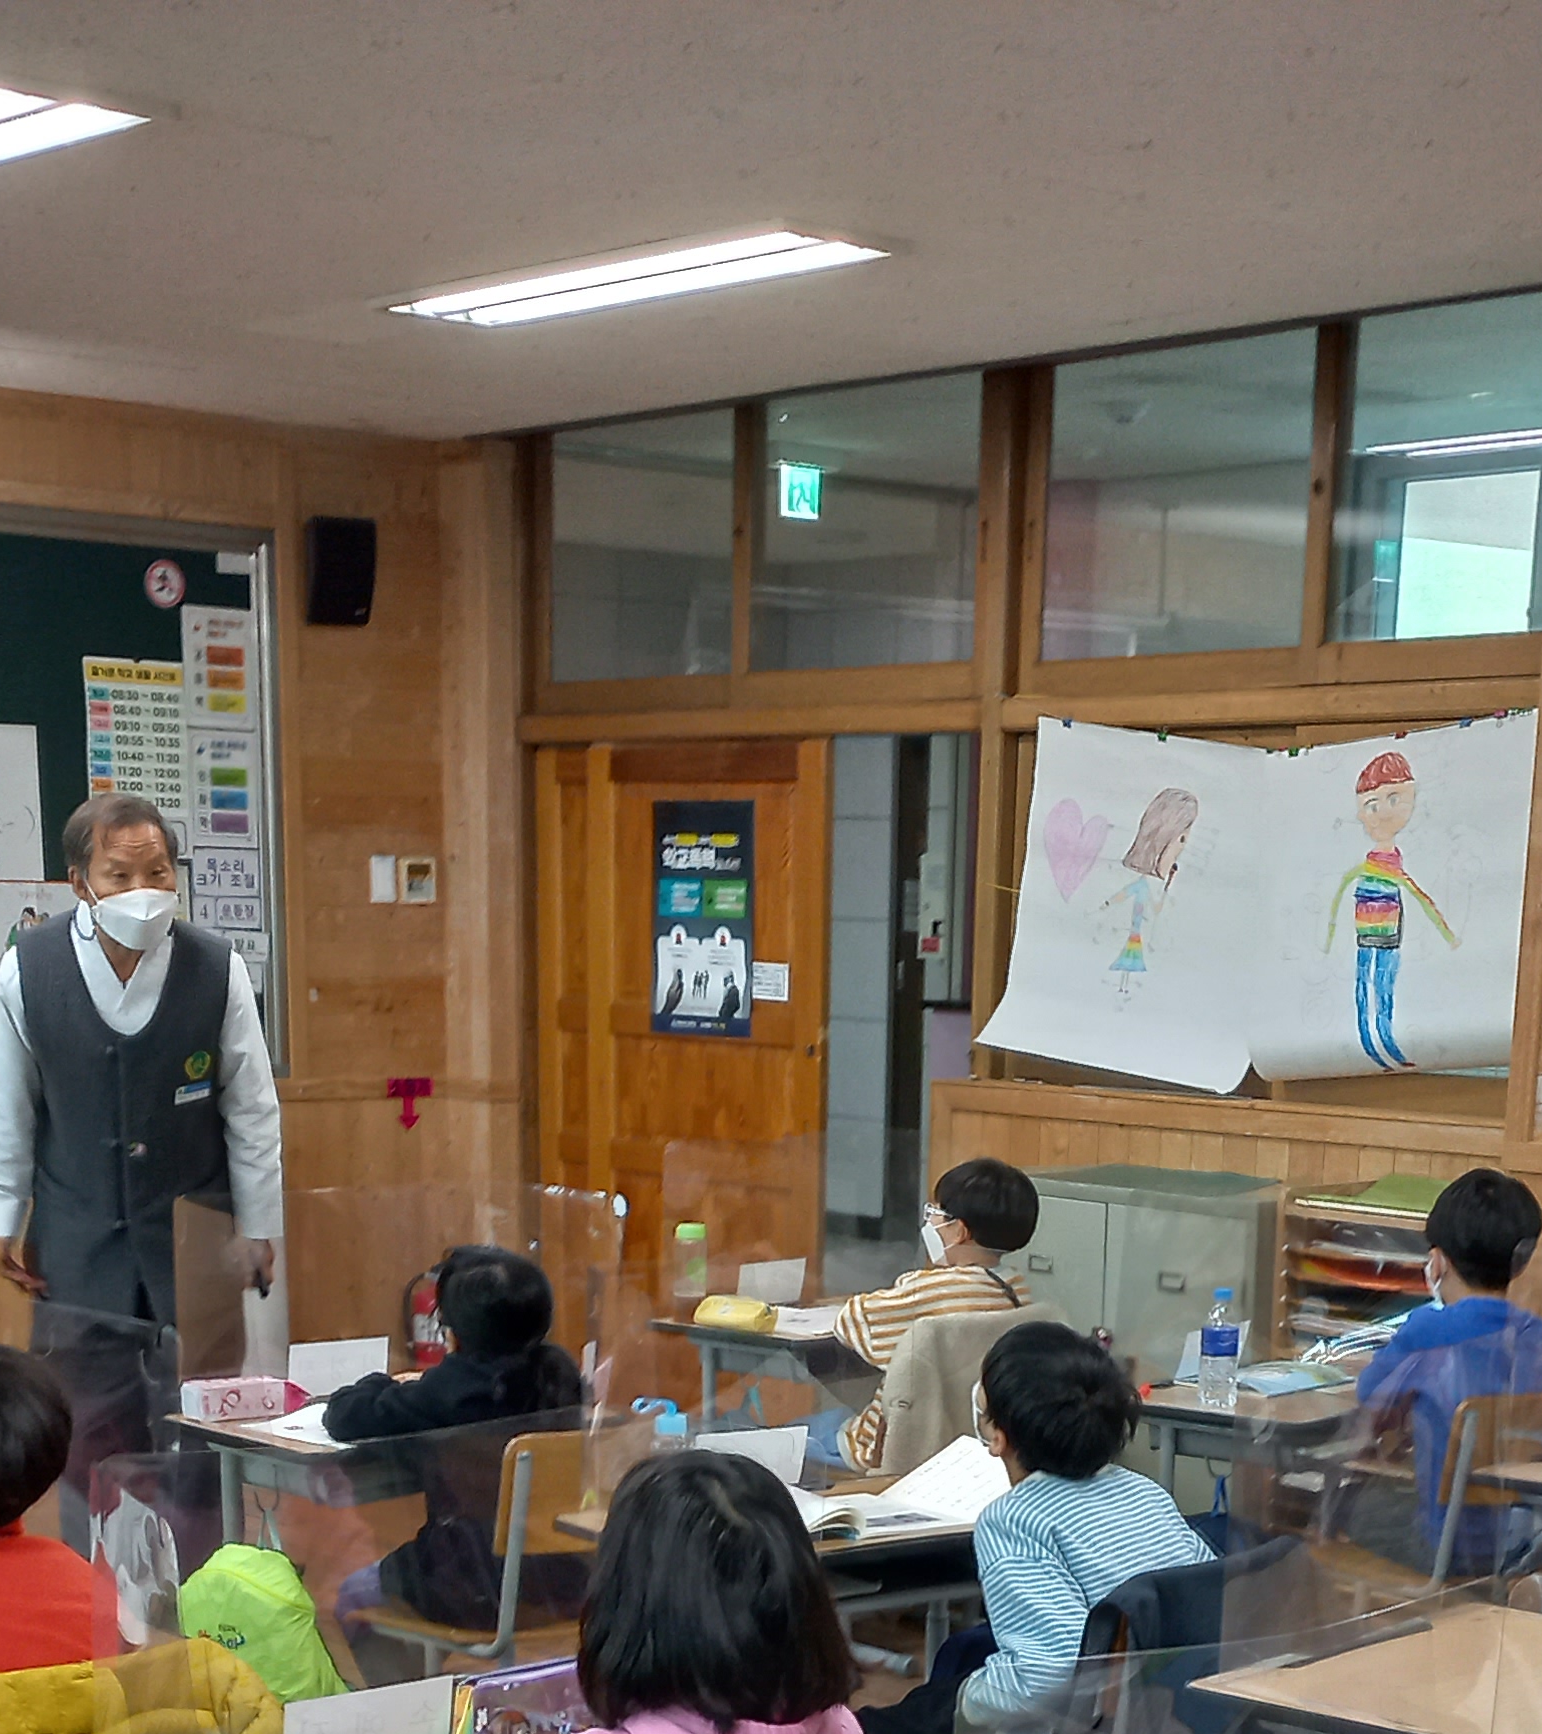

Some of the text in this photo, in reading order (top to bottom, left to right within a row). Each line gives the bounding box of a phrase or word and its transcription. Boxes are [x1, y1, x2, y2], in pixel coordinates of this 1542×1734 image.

[155, 737, 180, 748] 10:35
[117, 751, 144, 762] 10:40
[118, 766, 180, 778] 11:20 12:00
[117, 780, 181, 793] 12:00 12:40
[155, 797, 181, 809] 13:20
[207, 858, 244, 874] 목소리
[196, 873, 221, 888] 크기
[200, 904, 208, 919] 4
